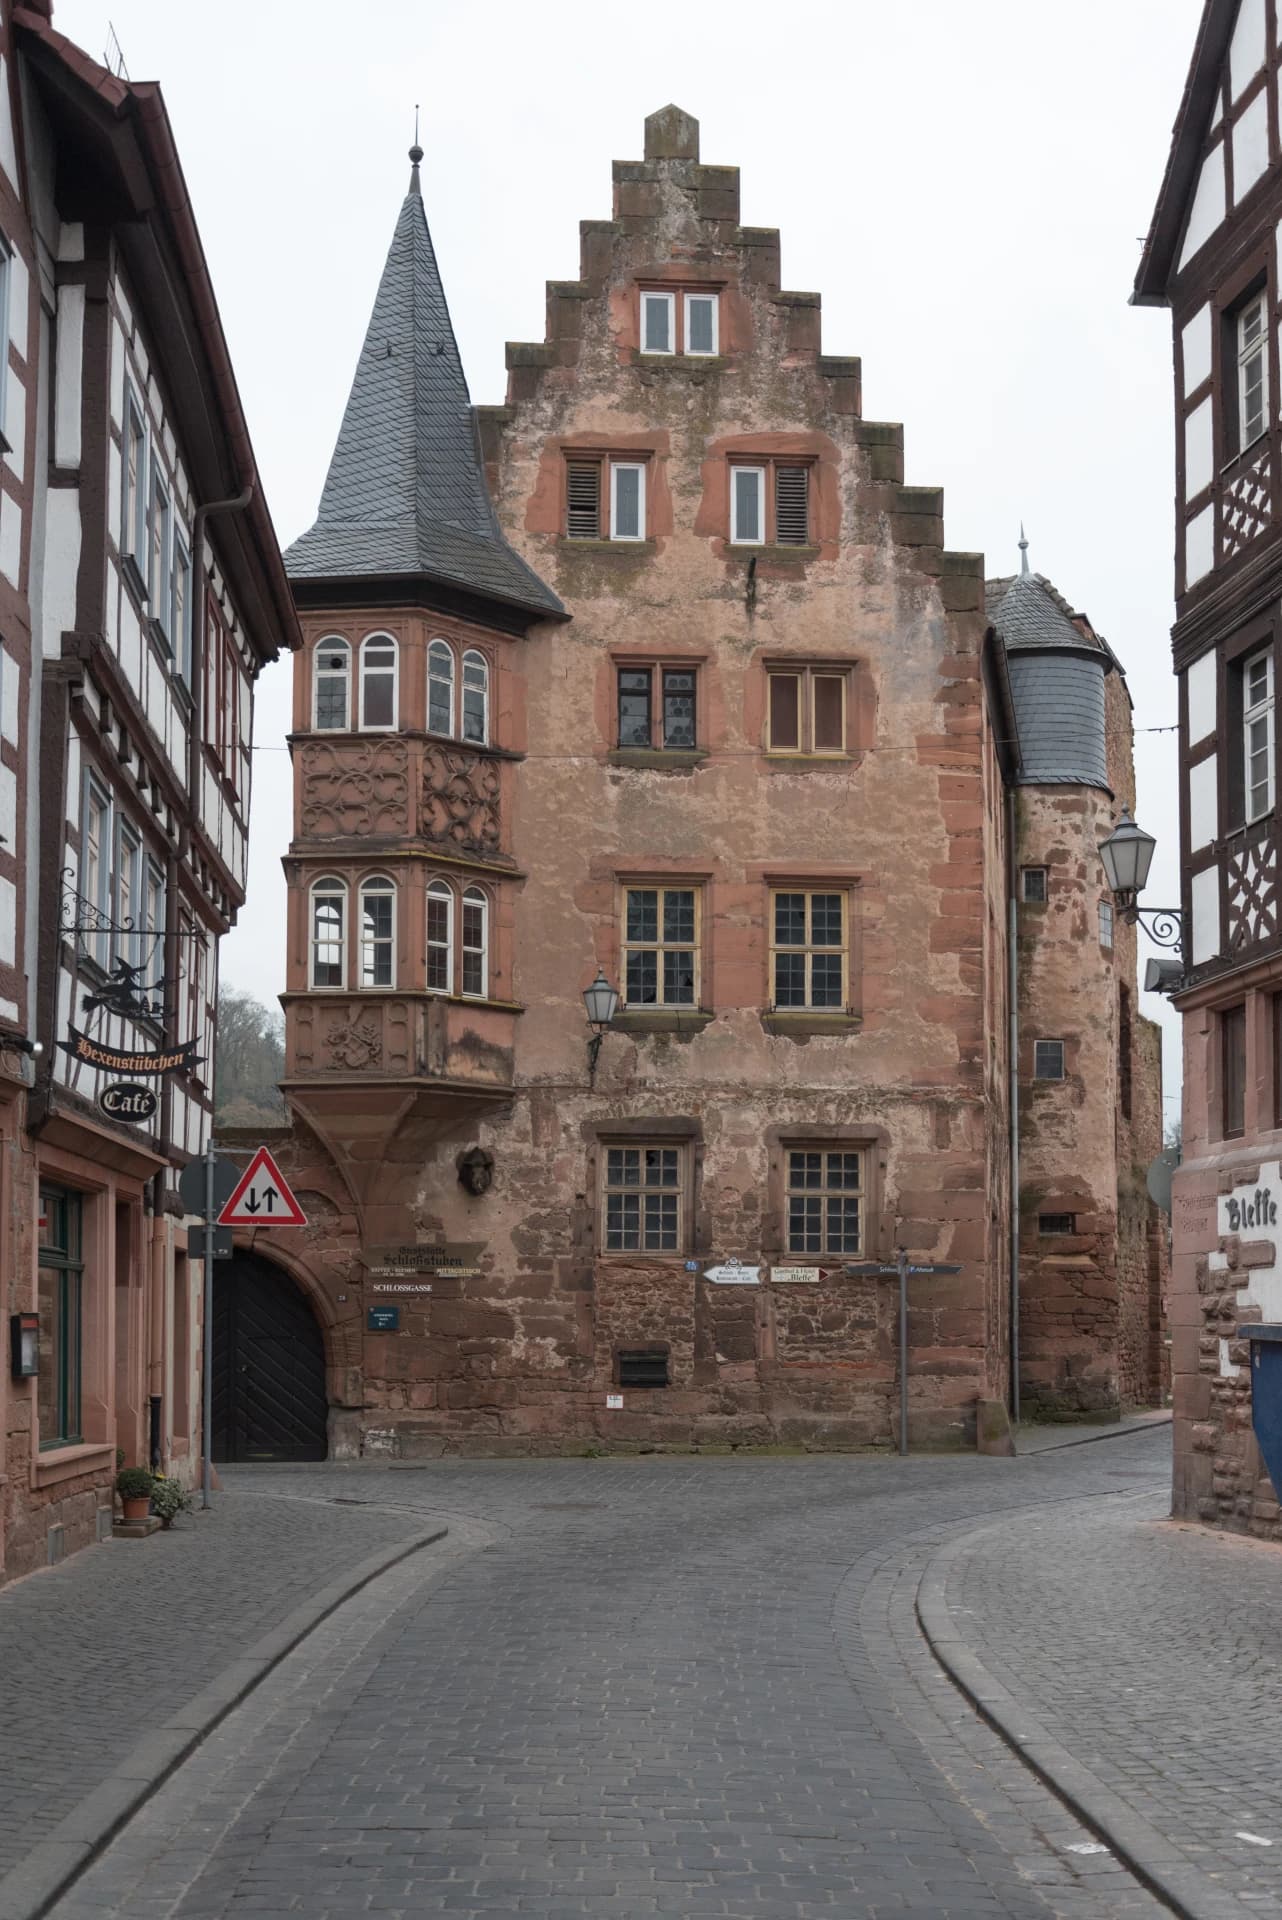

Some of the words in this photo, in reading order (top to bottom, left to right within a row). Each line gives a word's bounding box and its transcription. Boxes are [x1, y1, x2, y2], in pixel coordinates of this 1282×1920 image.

[76, 1037, 184, 1072] Hexenstübchen
[103, 1090, 150, 1113] Café
[1225, 1187, 1278, 1231] Bleffe
[373, 1284, 432, 1292] SCHLOSSGASSE
